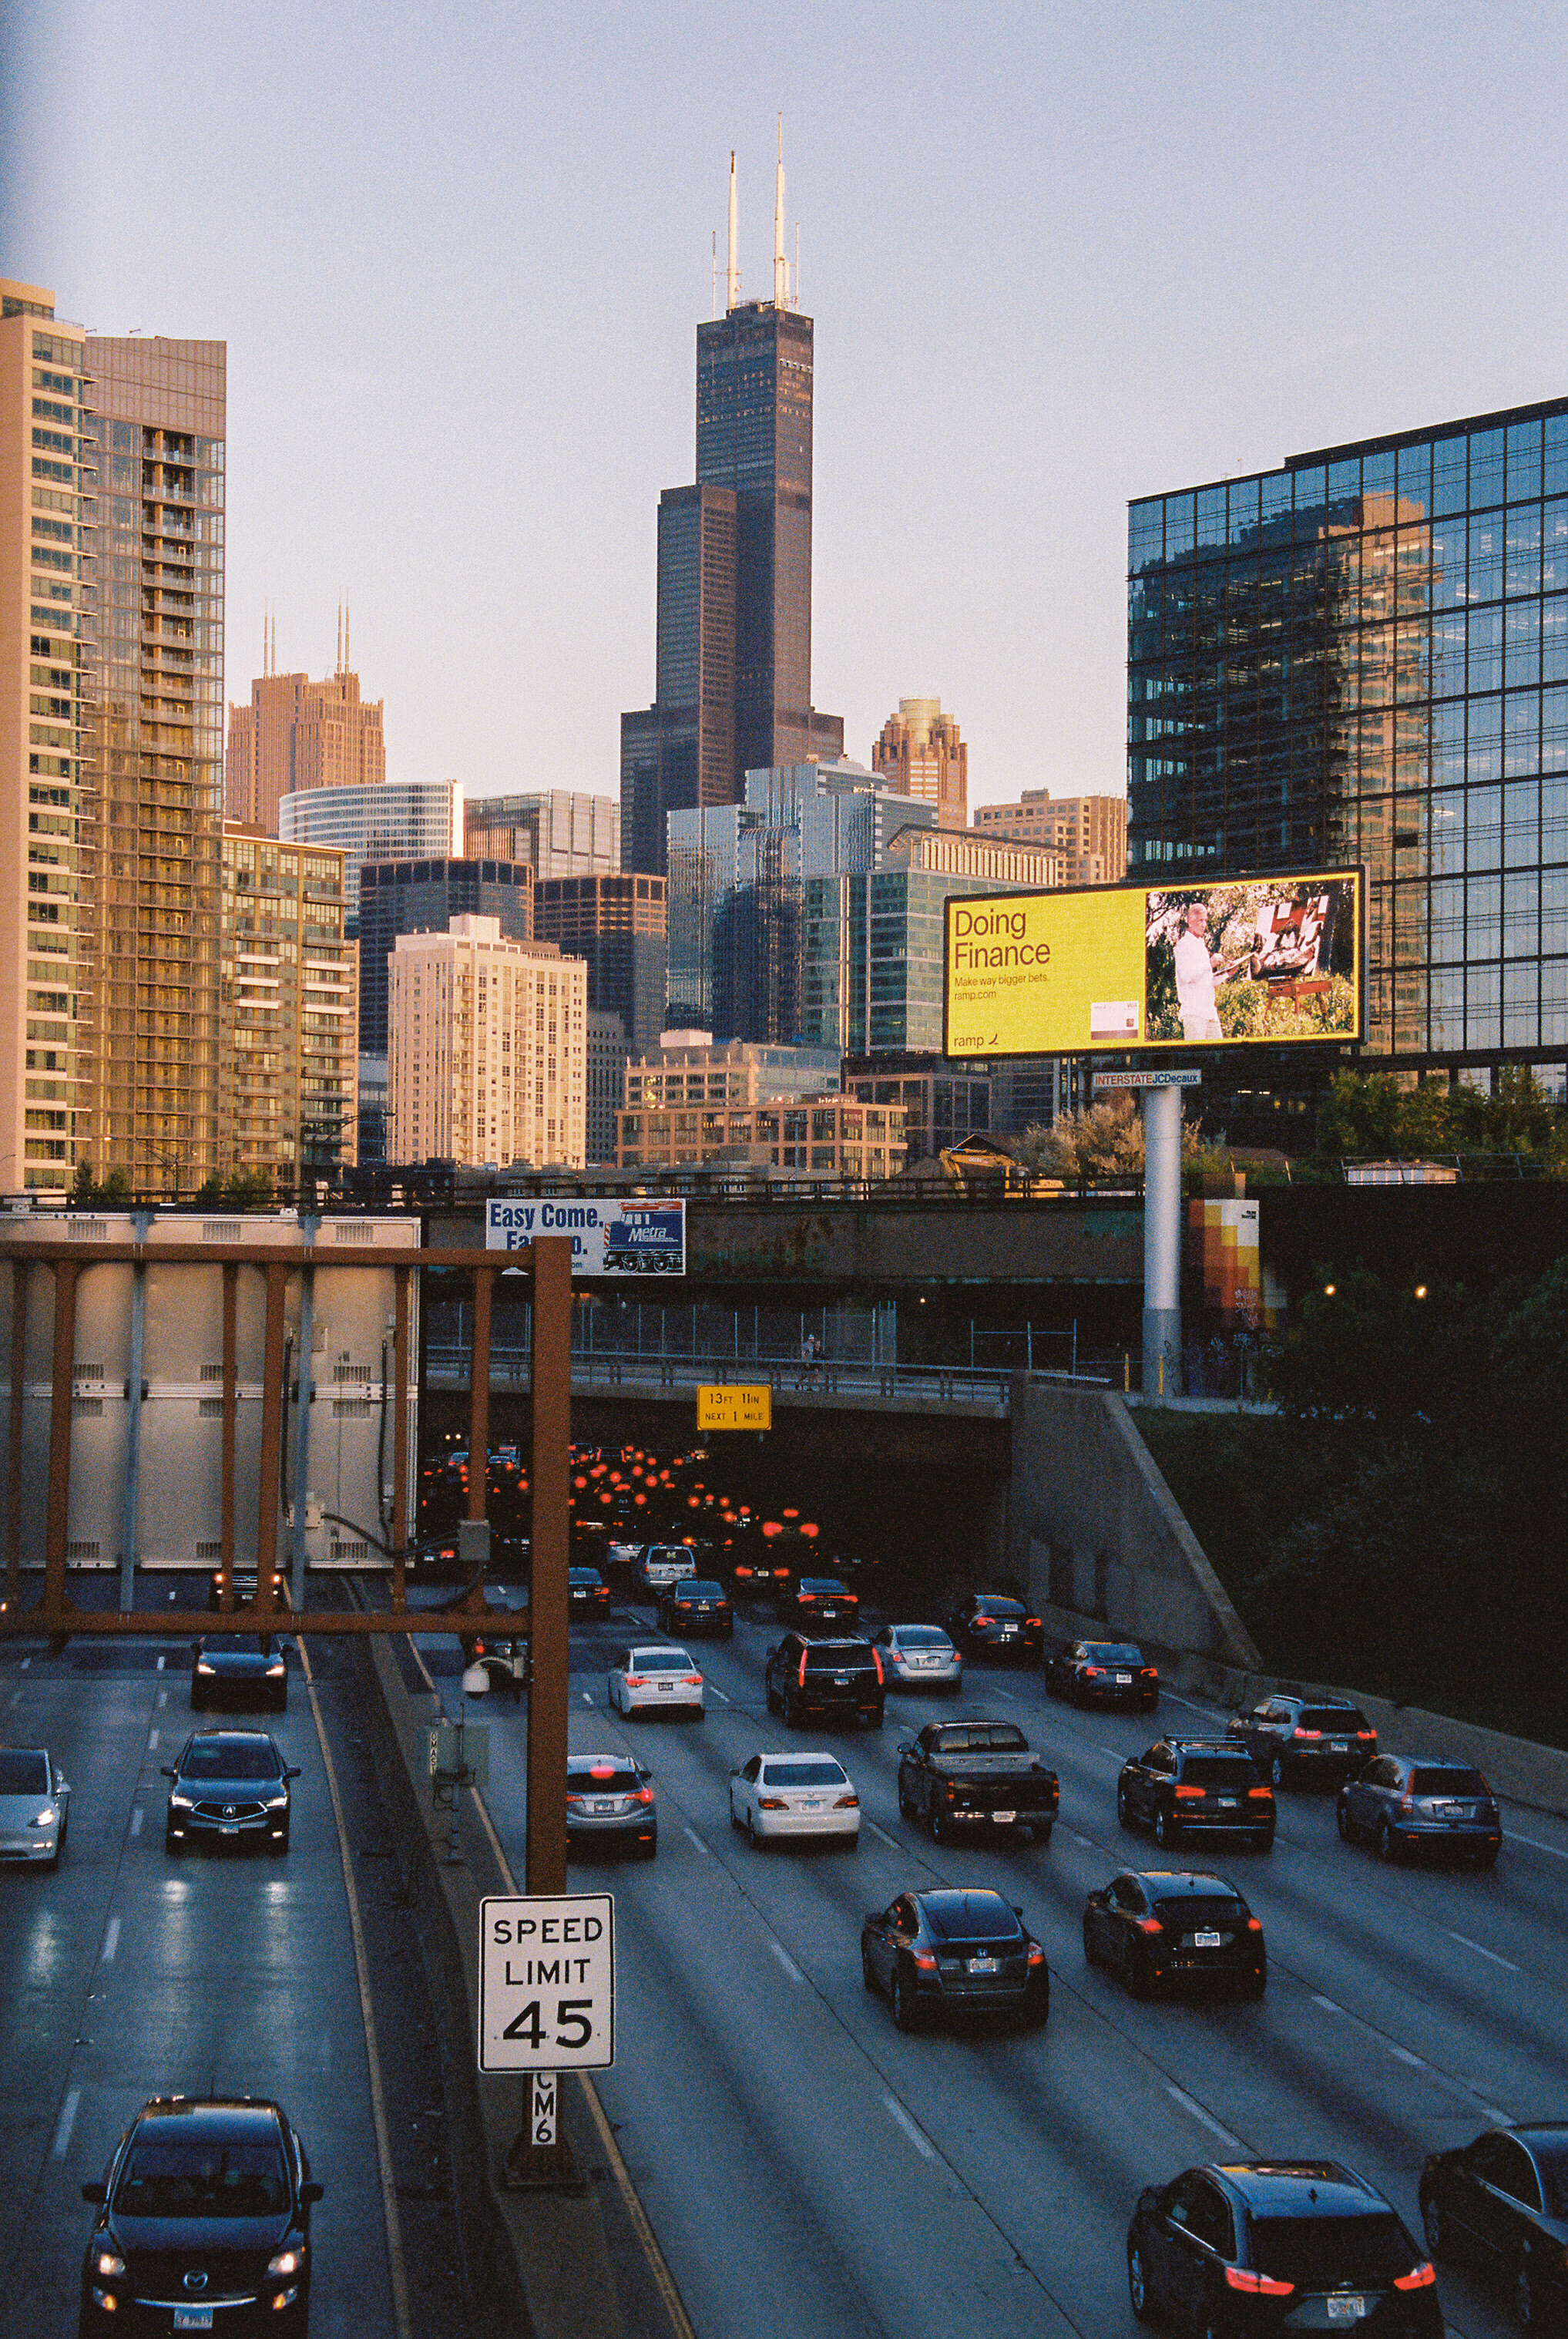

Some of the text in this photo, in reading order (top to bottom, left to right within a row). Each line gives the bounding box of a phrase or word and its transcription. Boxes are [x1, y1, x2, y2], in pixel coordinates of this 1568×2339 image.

[955, 908, 1026, 939] Doing
[955, 942, 1050, 969] Finance
[955, 973, 1049, 987] Make way bigger bets.
[955, 990, 997, 1001] ramp.com
[954, 1036, 984, 1049] ramp
[491, 1203, 603, 1230] Easy Come.
[628, 1227, 666, 1242] Metra
[705, 1411, 764, 1422] NEXT 1 MILE
[493, 1917, 603, 1944] SPEED
[505, 1958, 591, 1985] LIMIT
[503, 1999, 593, 2049] 45
